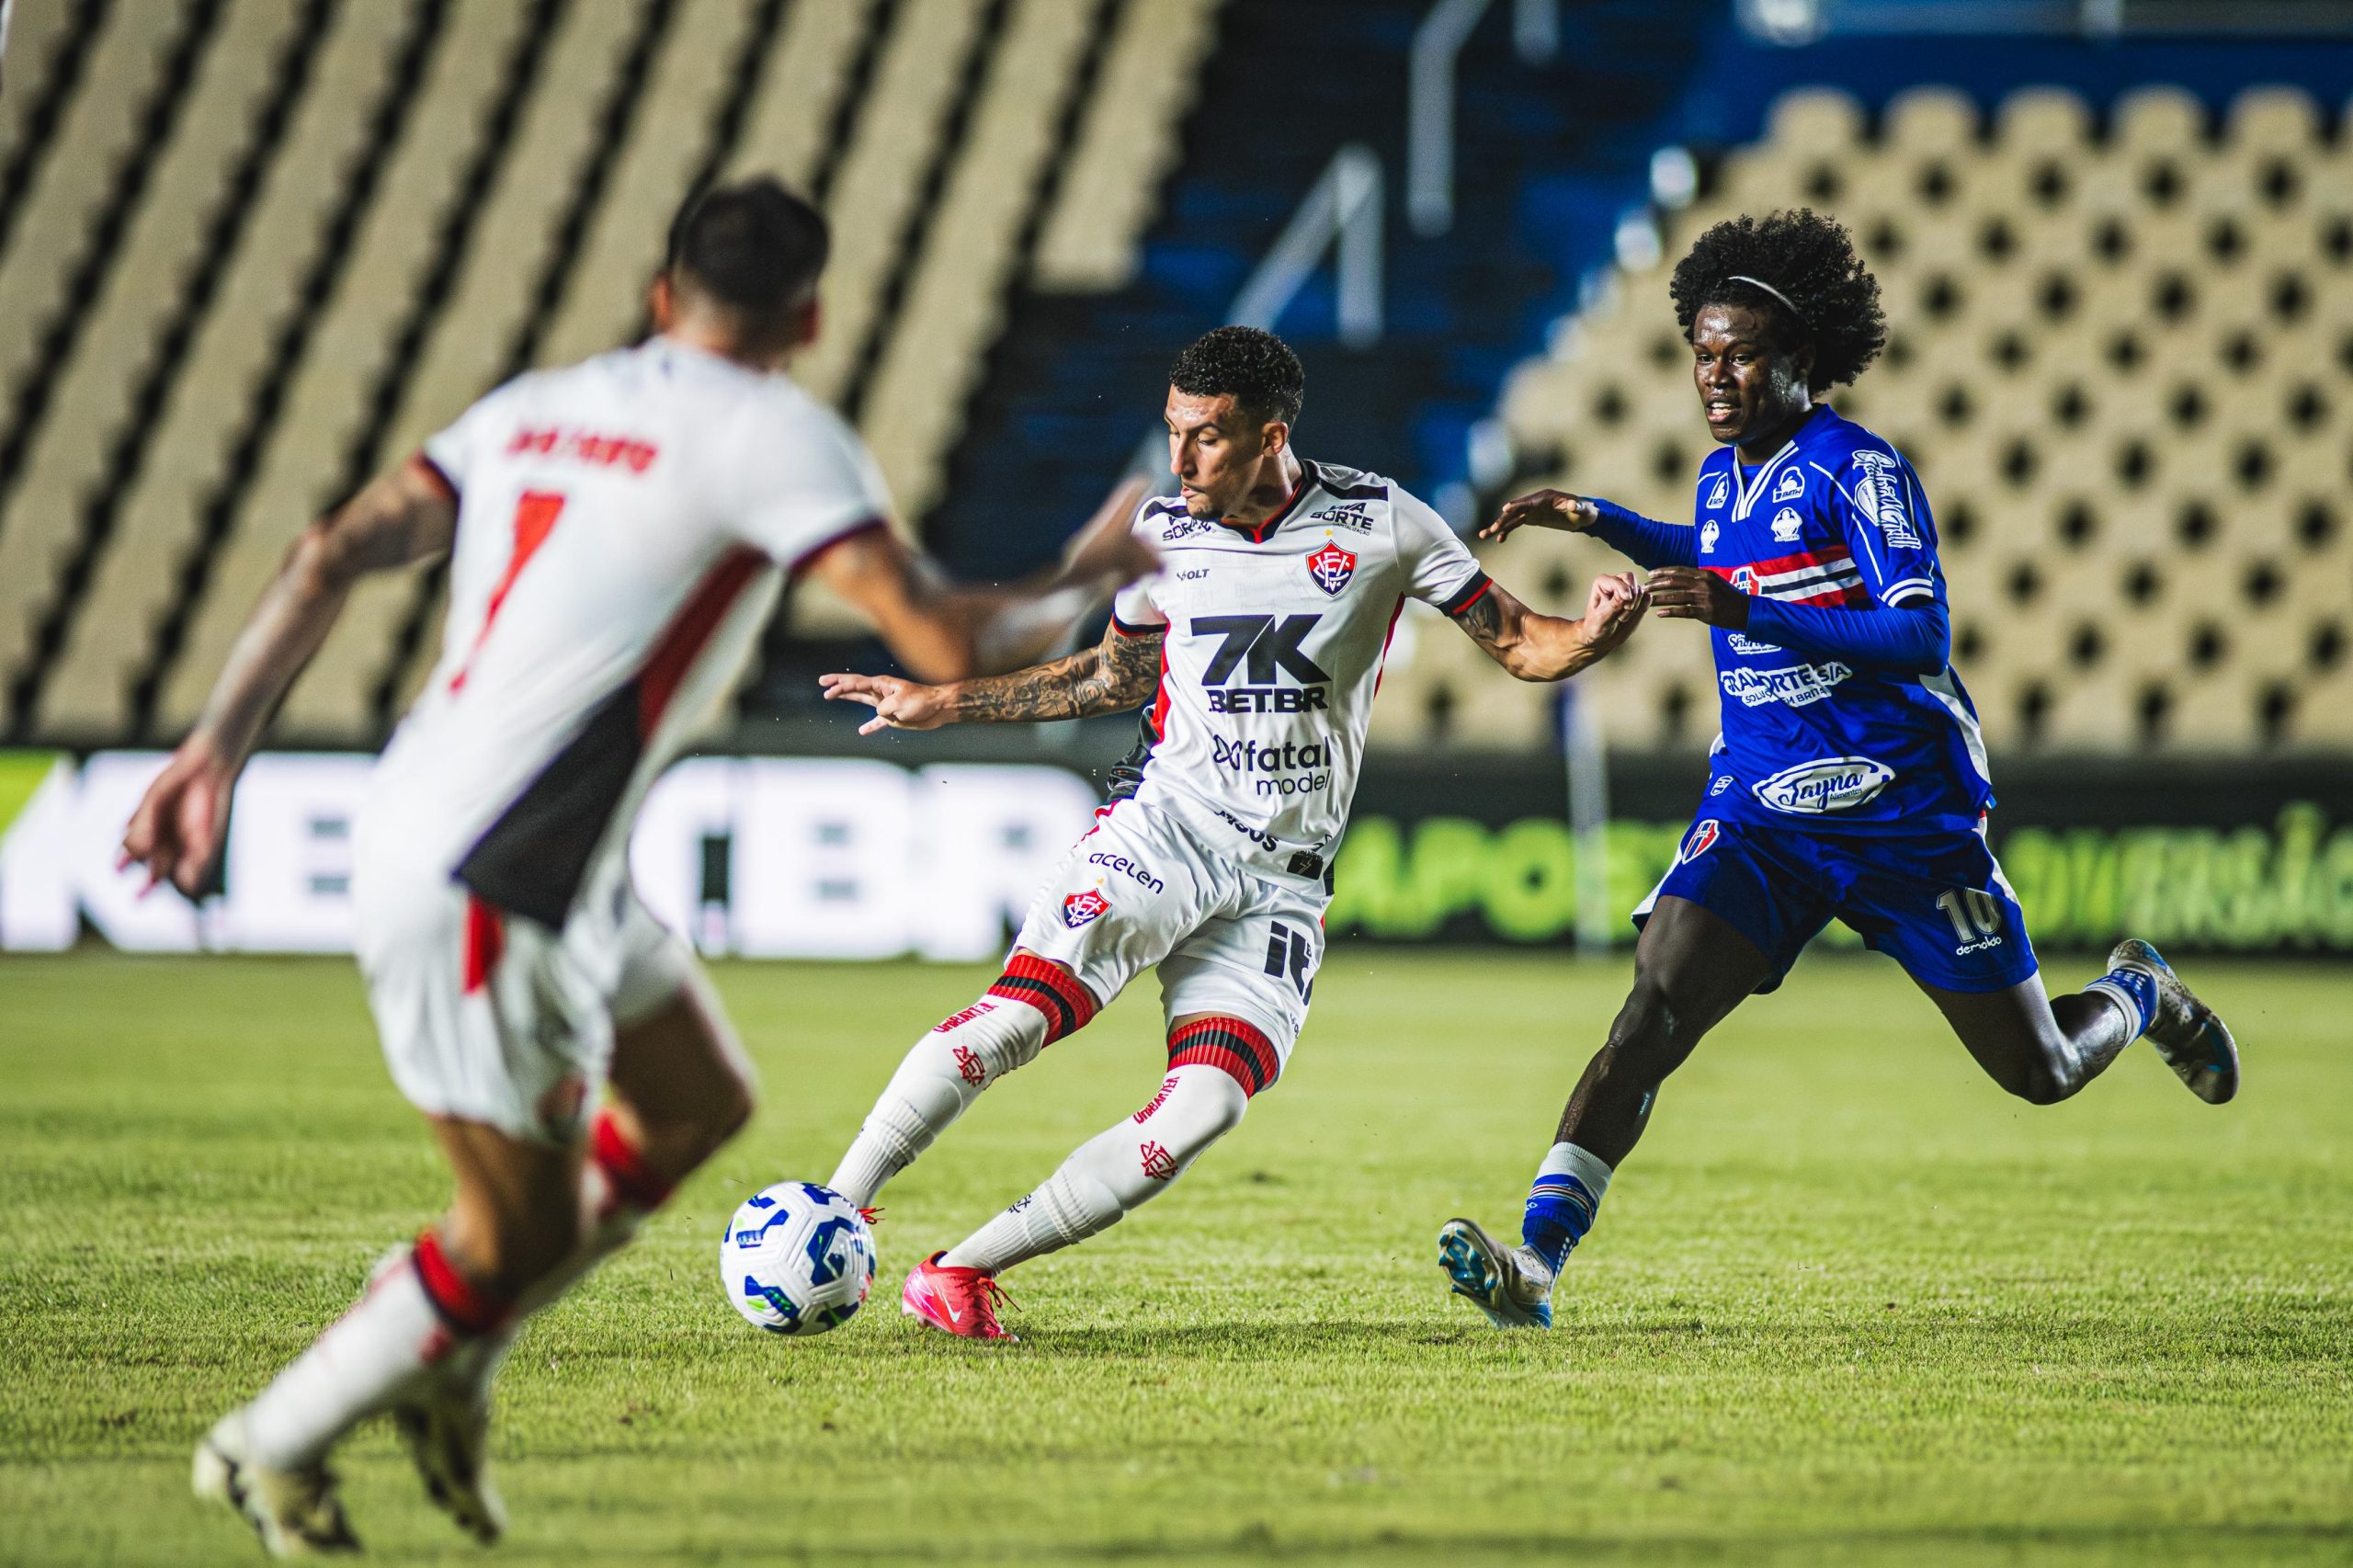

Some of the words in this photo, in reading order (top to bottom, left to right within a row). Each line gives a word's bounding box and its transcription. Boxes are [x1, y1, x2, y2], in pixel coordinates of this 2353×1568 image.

[1310, 510, 1374, 531] SORTE
[1190, 614, 1332, 686] 7K
[1206, 687, 1329, 714] .BET.BR
[1245, 736, 1331, 772] fatal
[1256, 769, 1331, 796] model
[1089, 853, 1164, 894] acelen
[1936, 886, 2002, 944] 10
